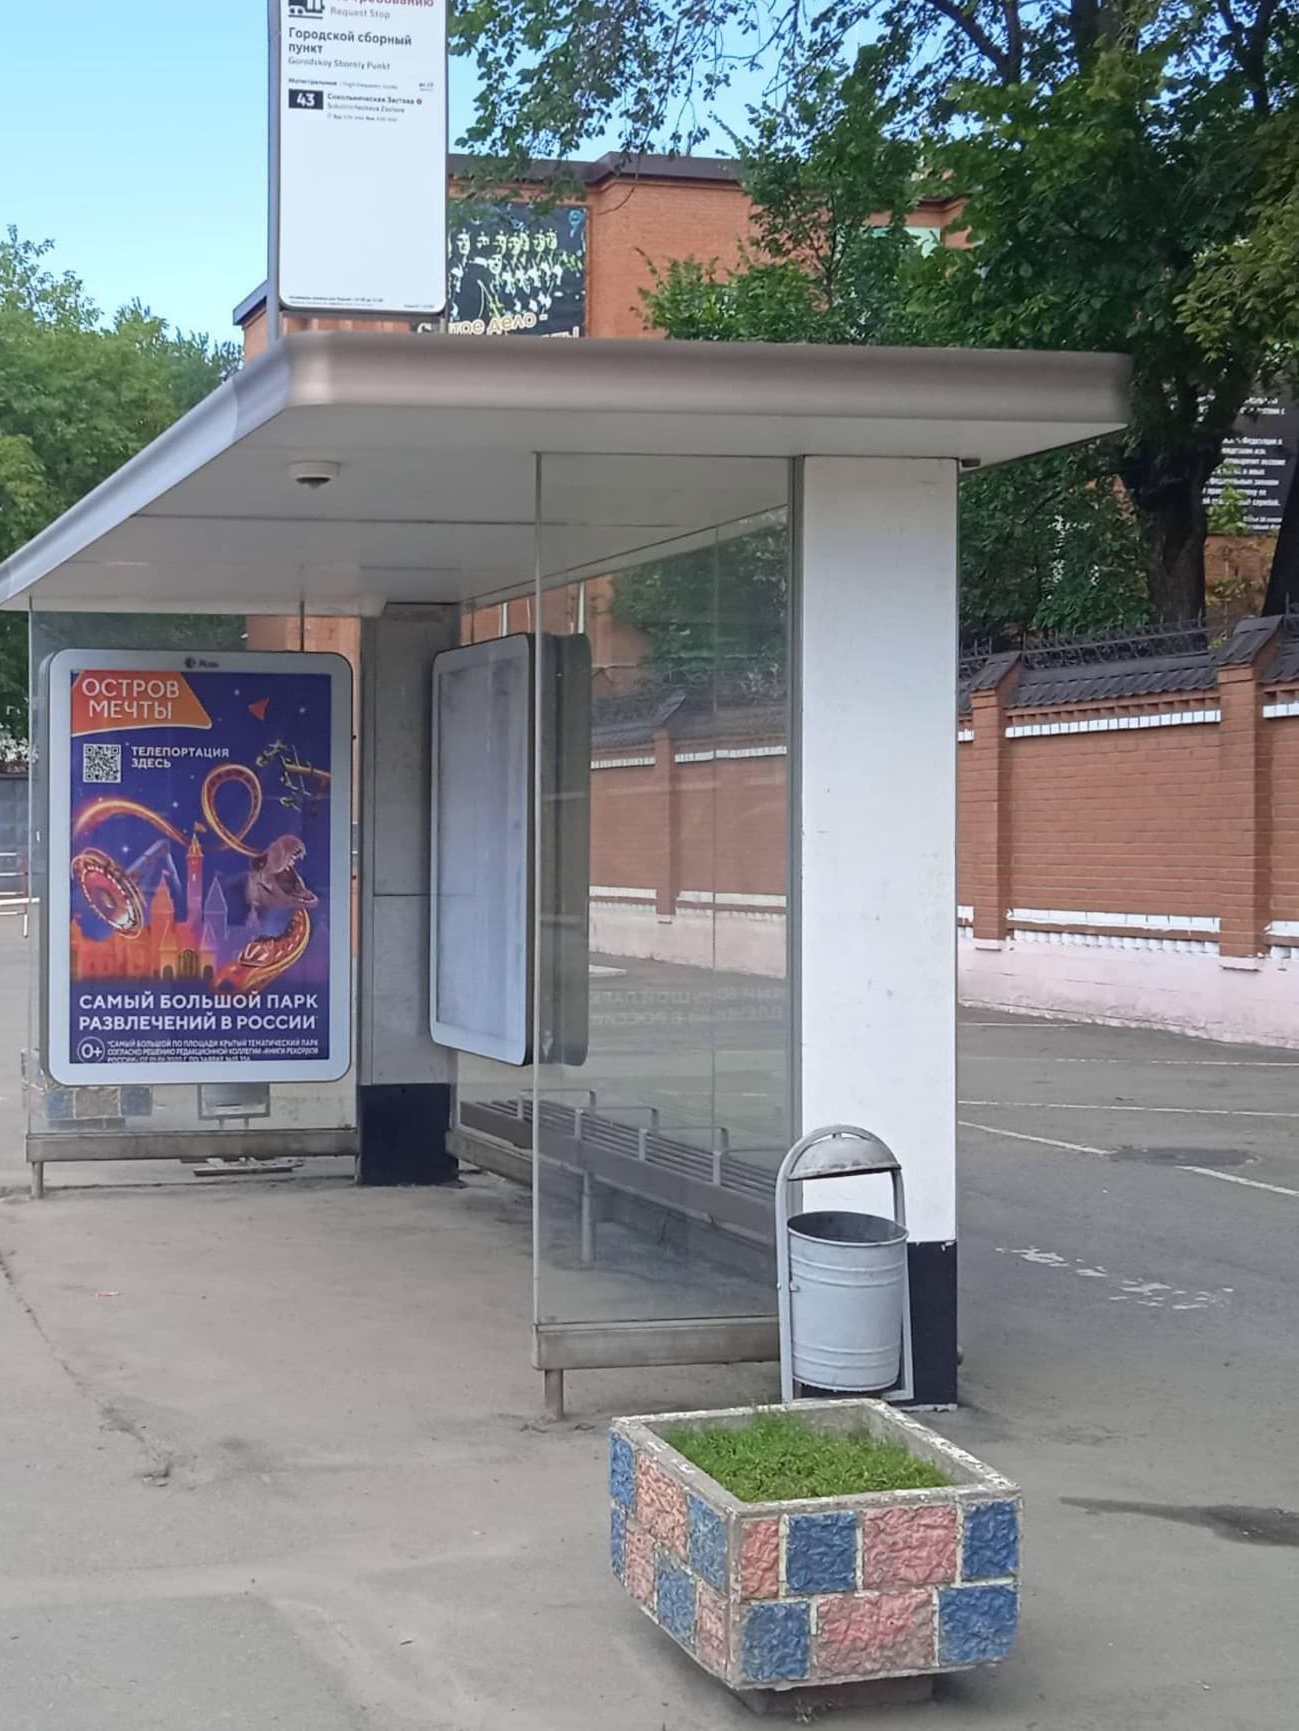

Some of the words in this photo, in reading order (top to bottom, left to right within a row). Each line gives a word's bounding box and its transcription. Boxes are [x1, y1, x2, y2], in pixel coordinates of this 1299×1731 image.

[330, 6, 367, 17] Request
[370, 9, 391, 19] Stop
[288, 27, 354, 42] Городской
[358, 32, 412, 46] сборный
[288, 43, 323, 55] пункт
[296, 92, 315, 107] 43
[82, 678, 180, 698] ОСТРОВ
[88, 700, 173, 720] МЕЧТЫ
[130, 746, 230, 759] ТЕЛЕПОРТАЦИЯ
[130, 758, 172, 769] ЗДЕСЬ
[79, 991, 154, 1010] САМЫЙ
[160, 990, 261, 1009] БОЛЬШОЙ
[267, 994, 319, 1009] ПАРК
[79, 1012, 216, 1031] РАЗВЛЕЧЕНИЙ
[221, 1016, 232, 1030] В
[81, 1043, 103, 1059] 0+
